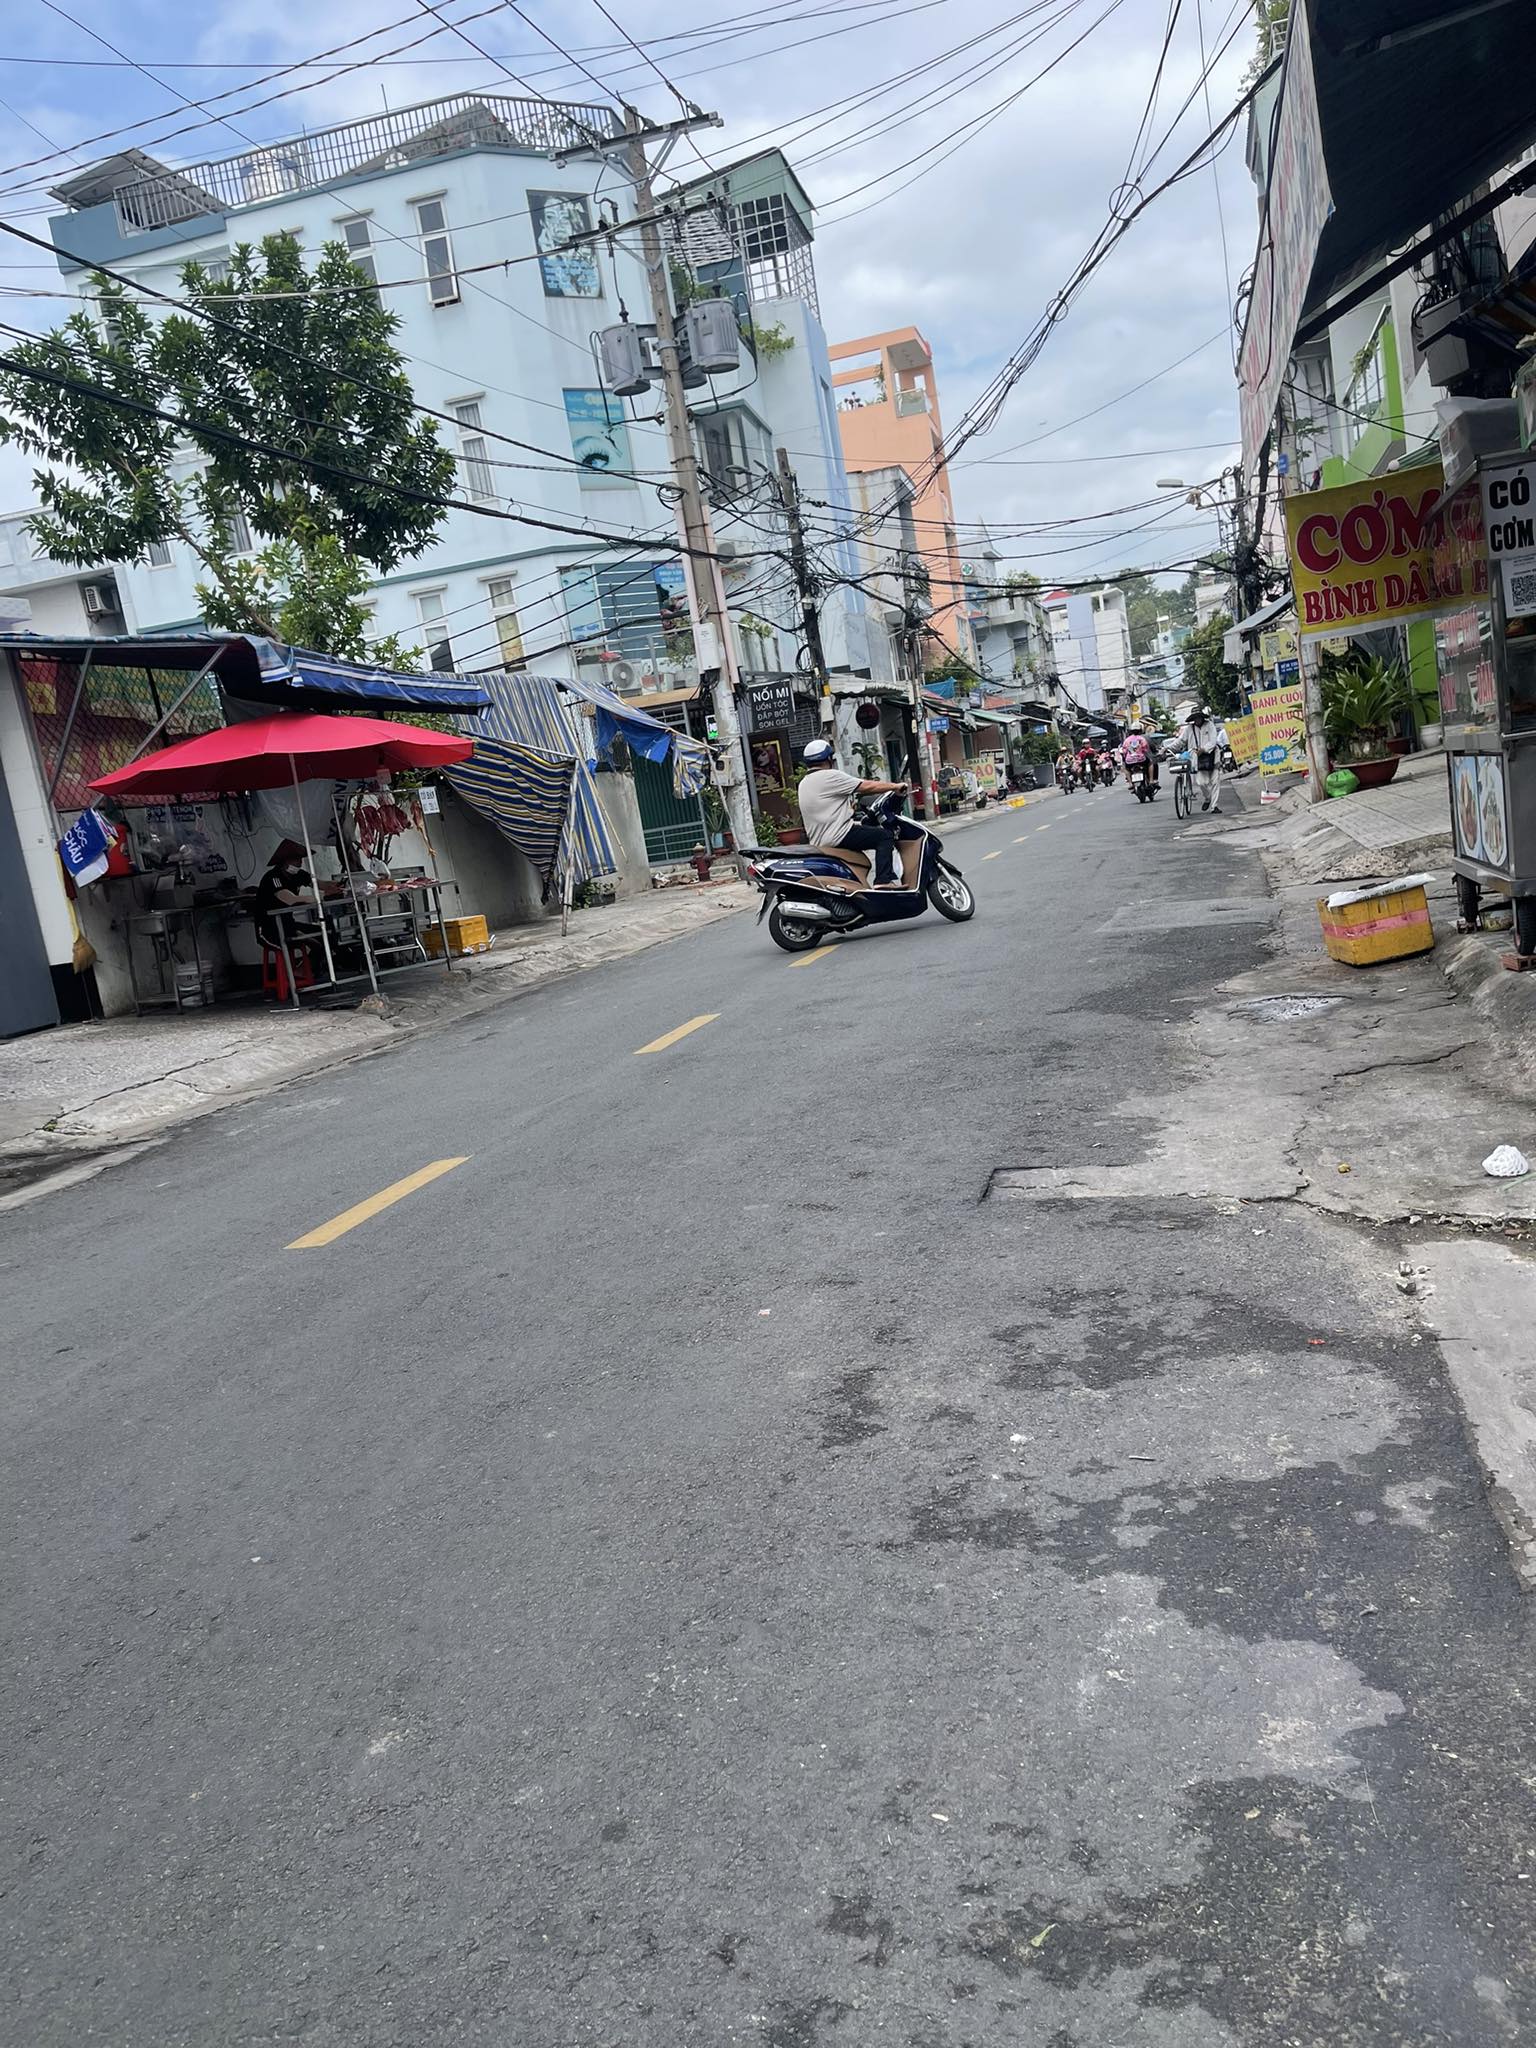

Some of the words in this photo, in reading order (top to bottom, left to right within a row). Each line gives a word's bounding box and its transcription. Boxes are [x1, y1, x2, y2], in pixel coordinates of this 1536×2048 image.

[1489, 468, 1530, 509] CÓ
[1490, 516, 1535, 552] CƠM
[1304, 577, 1379, 625] BÌNH
[752, 686, 773, 703] NỐI
[776, 687, 789, 699] MI
